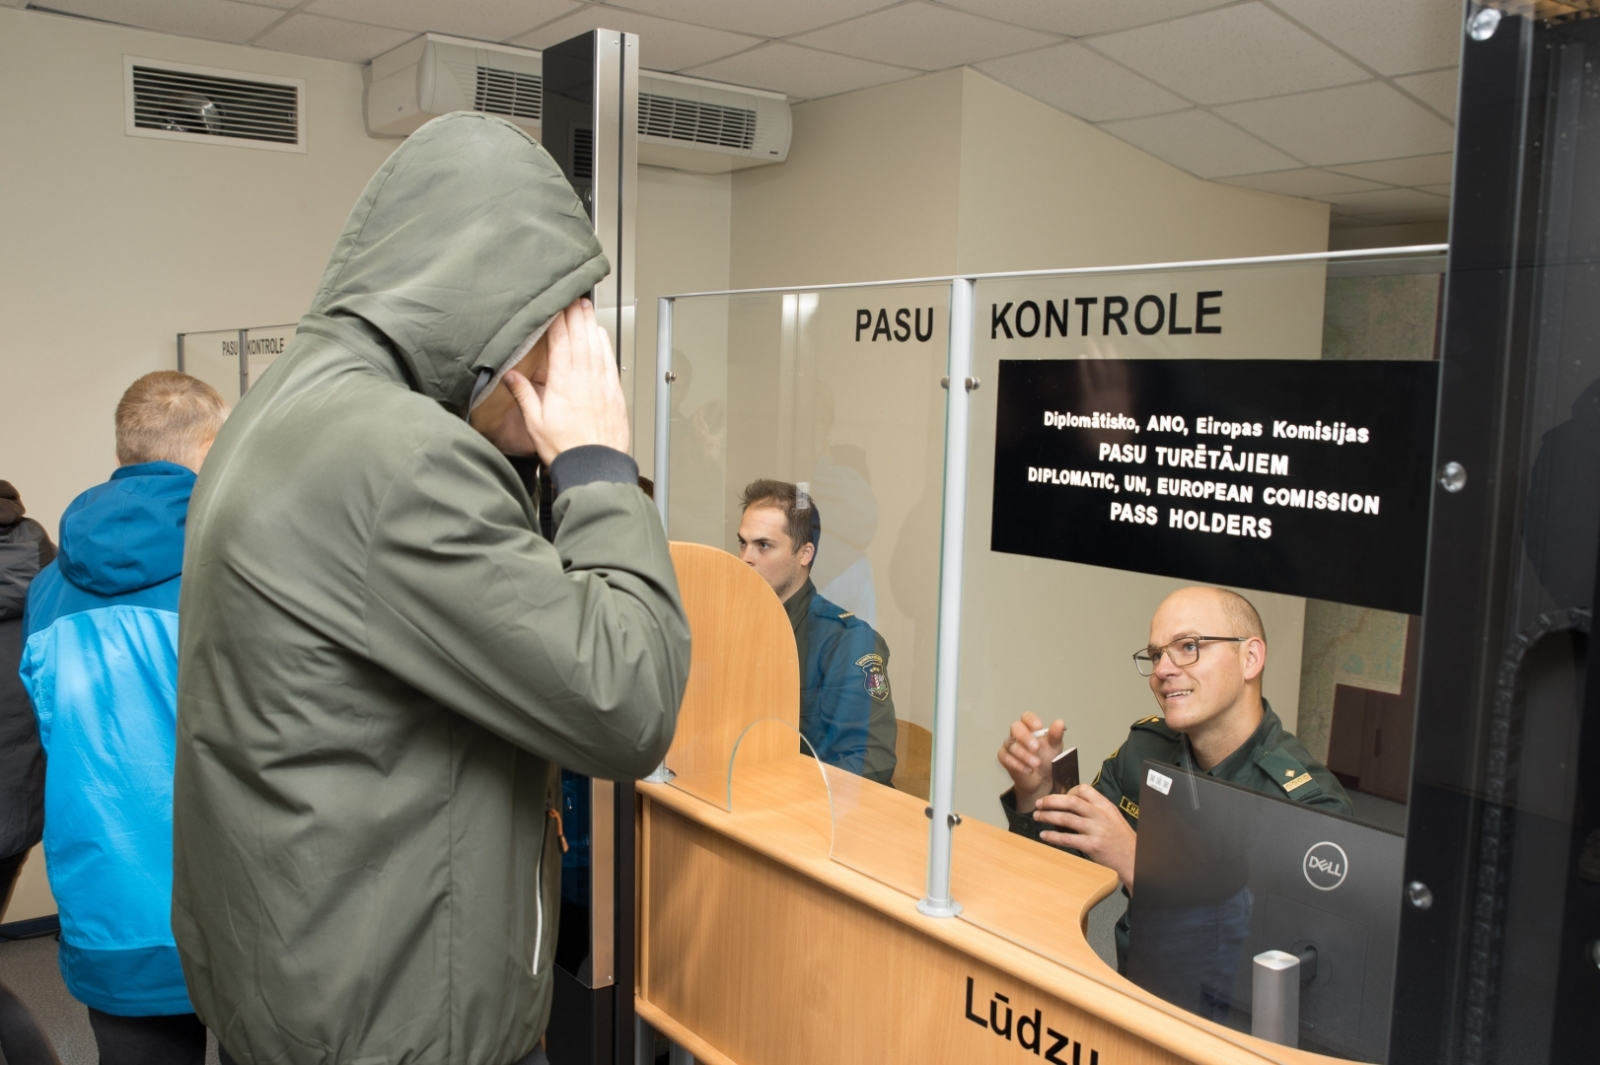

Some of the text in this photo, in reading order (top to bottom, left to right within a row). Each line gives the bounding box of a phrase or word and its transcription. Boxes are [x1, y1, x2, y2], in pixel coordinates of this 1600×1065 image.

[855, 290, 1223, 342] PASU KONTROLE
[222, 338, 284, 356] PASU KONTROLE
[1044, 411, 1370, 445] Diplomātisko, ANO, Eiropas Komisijas
[1099, 442, 1289, 476] PASU TURĒTĀJIEM
[1027, 466, 1380, 515] DIPLOMATIC, UN, EUROPEAN COMISSION
[1110, 502, 1272, 539] PASS HOLDERS
[1308, 855, 1342, 877] DELL
